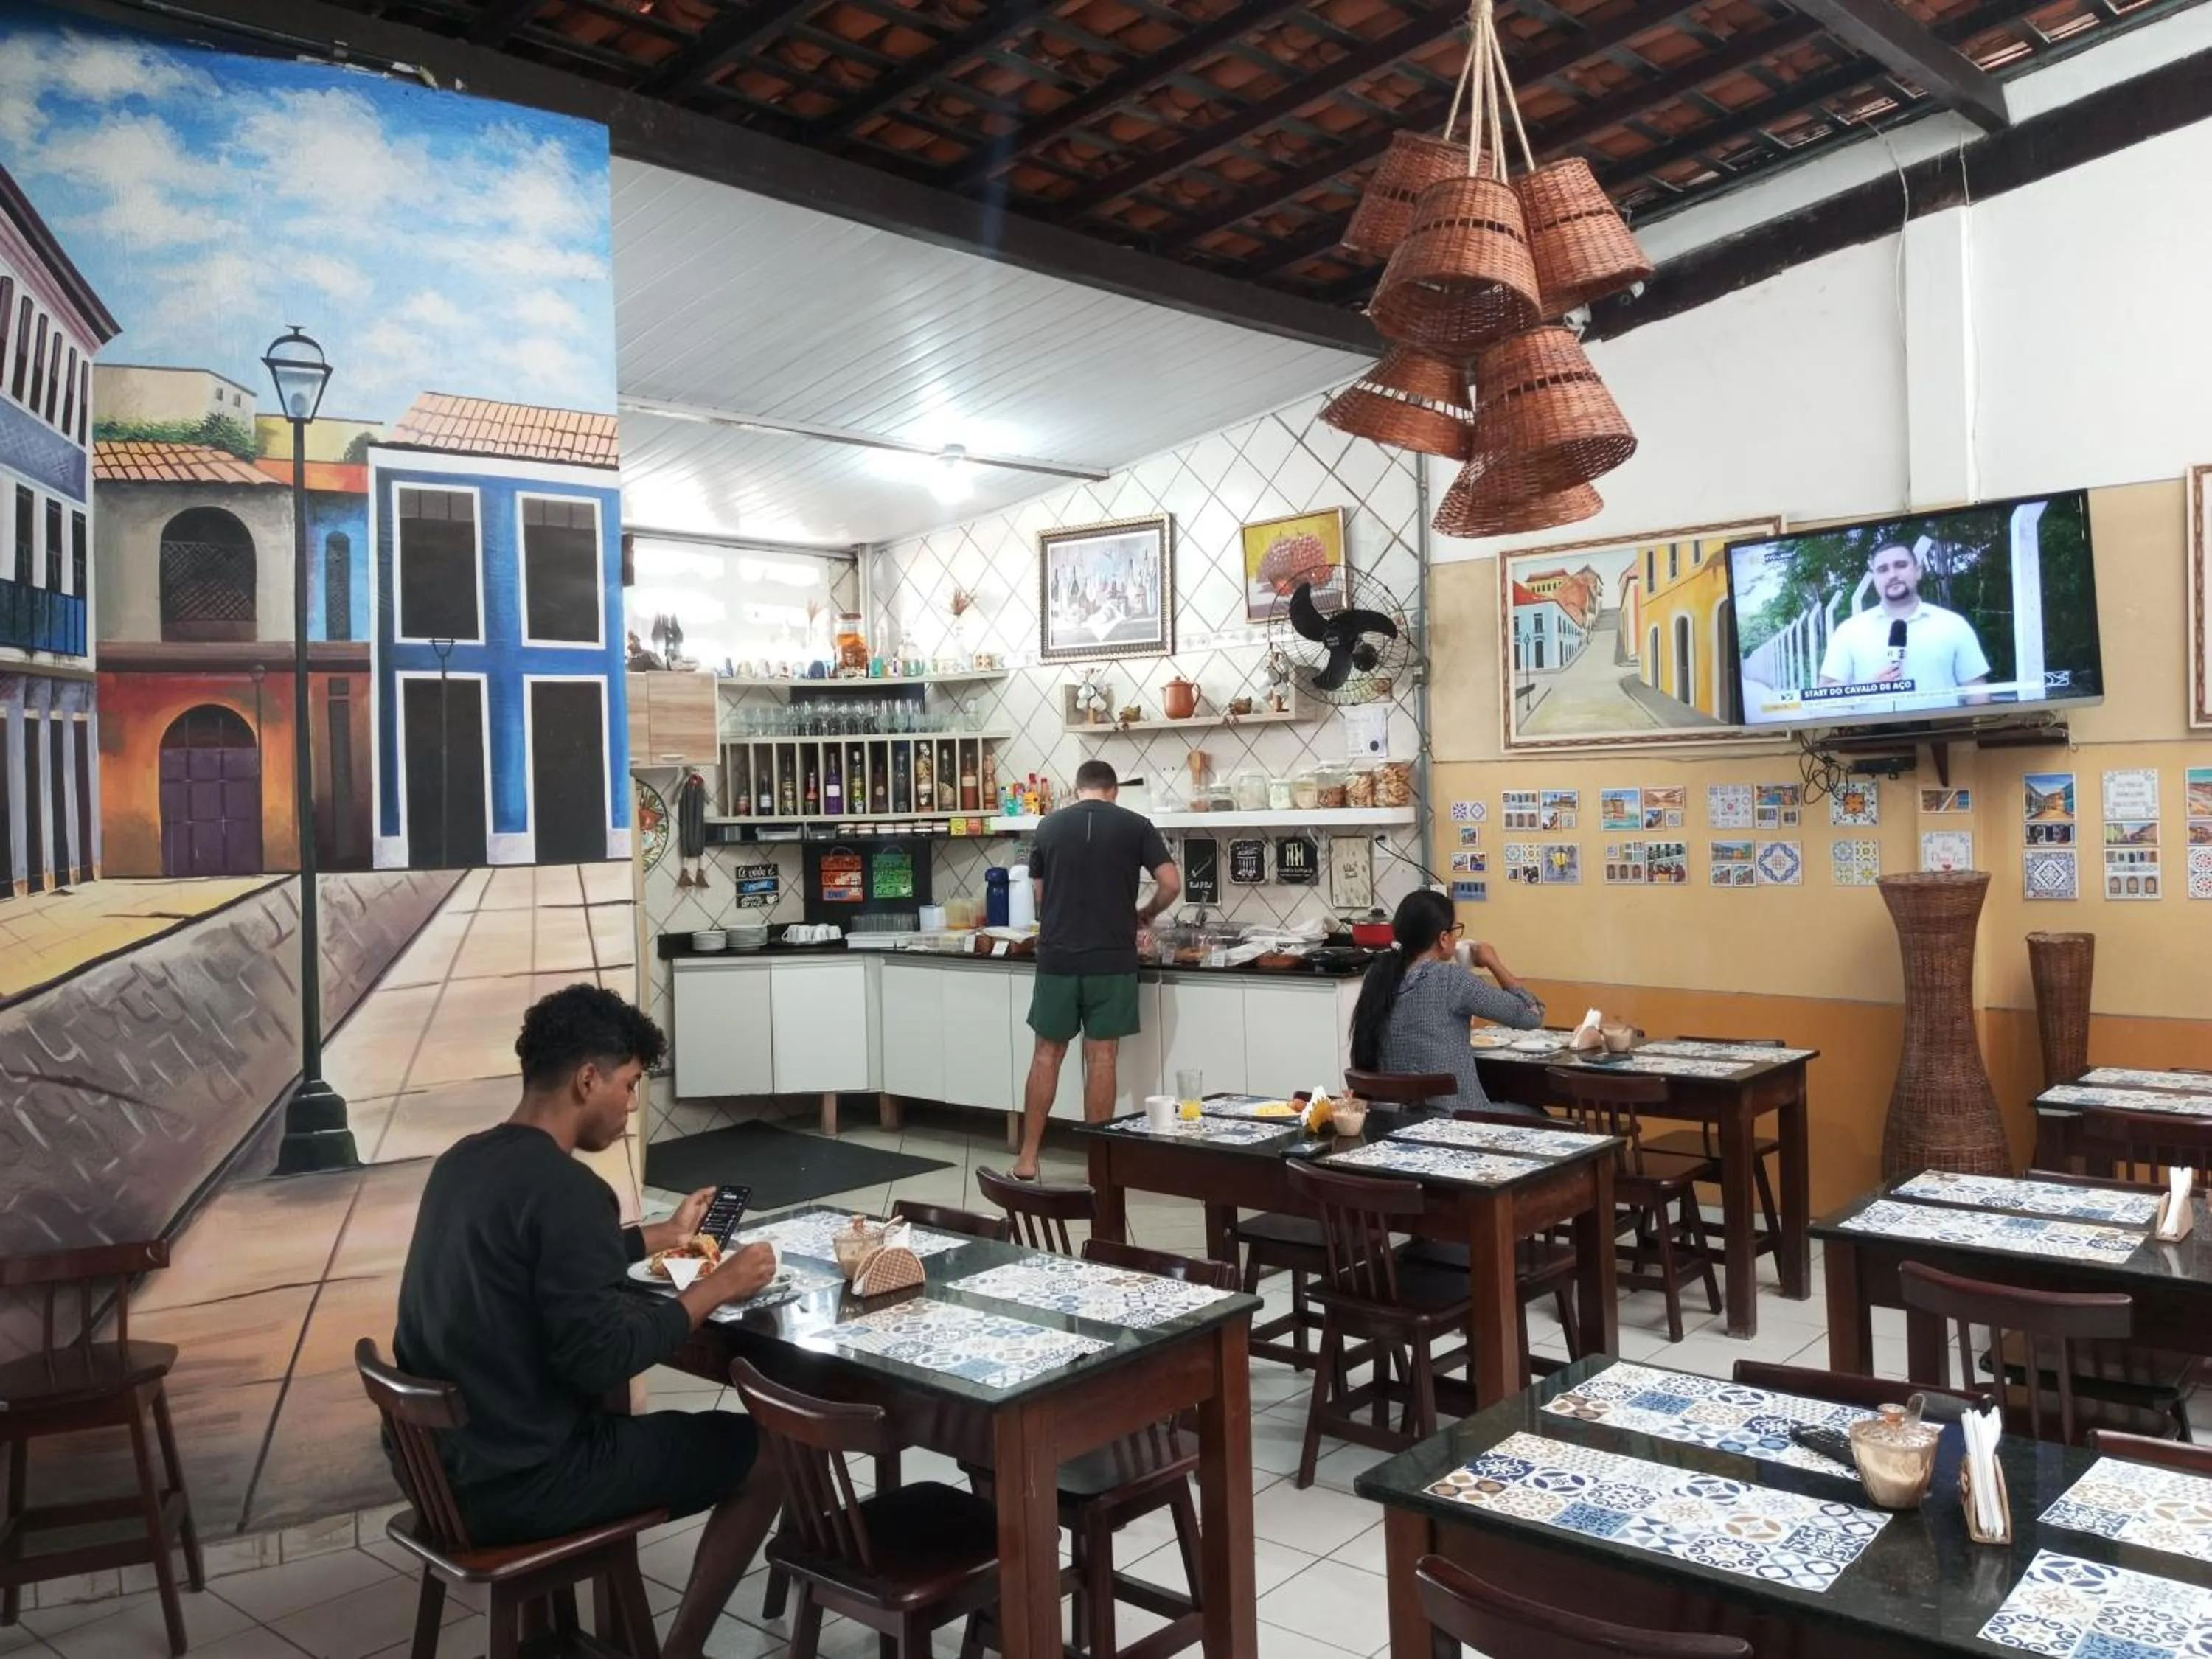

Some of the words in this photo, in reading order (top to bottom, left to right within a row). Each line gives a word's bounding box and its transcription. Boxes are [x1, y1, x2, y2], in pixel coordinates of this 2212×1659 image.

[1804, 688, 1828, 698] START
[1829, 686, 1843, 695] DO
[1844, 682, 1878, 694] CAVALO
[1879, 681, 1891, 691] DE
[1893, 680, 1912, 690] AÇO
